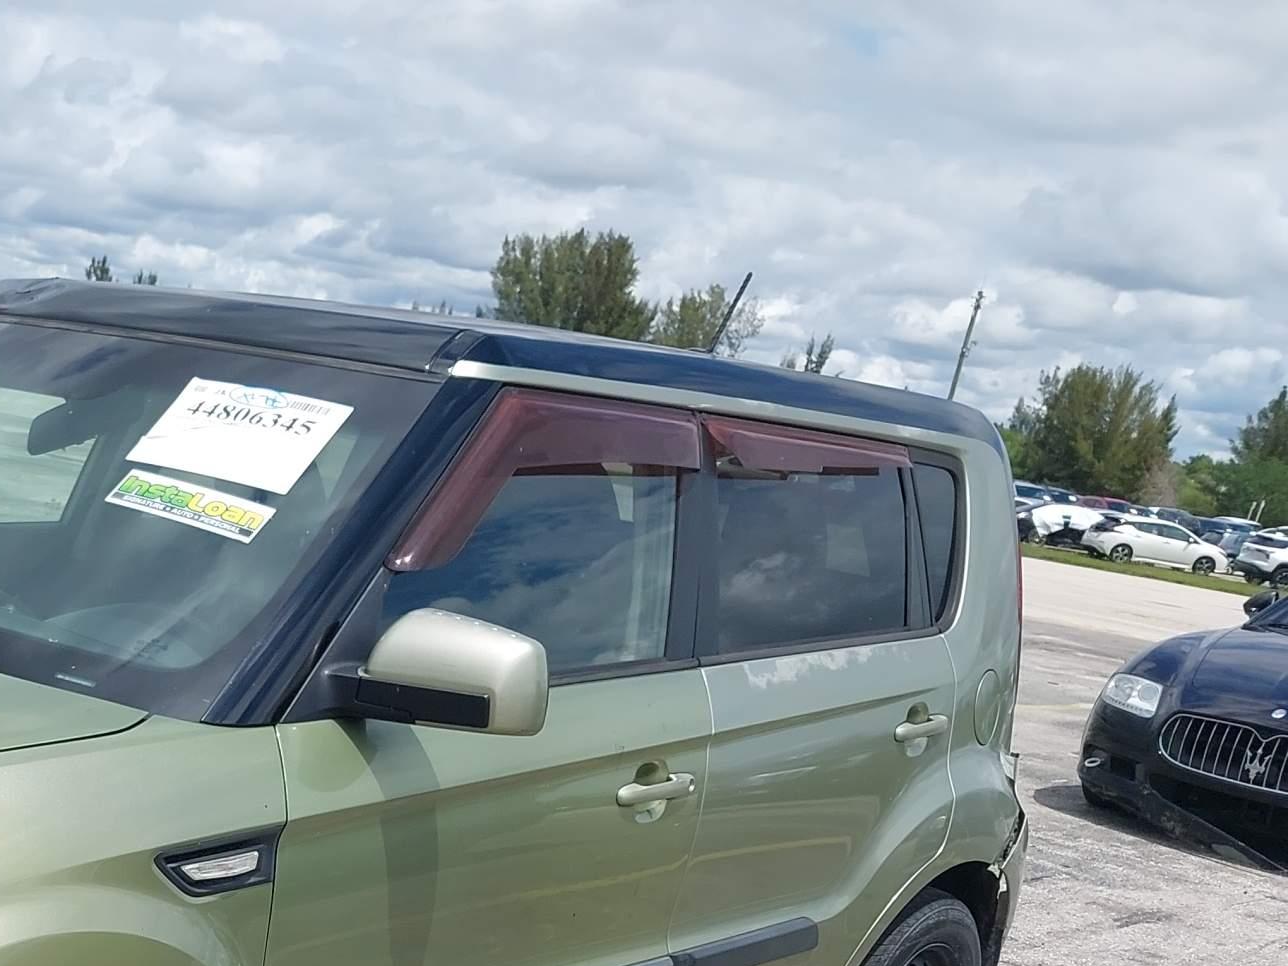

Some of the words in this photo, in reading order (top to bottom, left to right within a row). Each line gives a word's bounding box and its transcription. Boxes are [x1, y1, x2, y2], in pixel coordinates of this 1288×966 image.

[187, 400, 318, 436] 44806345
[119, 475, 265, 530] InstaLoan
[171, 507, 194, 519] AUTO
[199, 514, 241, 534] PERSONAL
